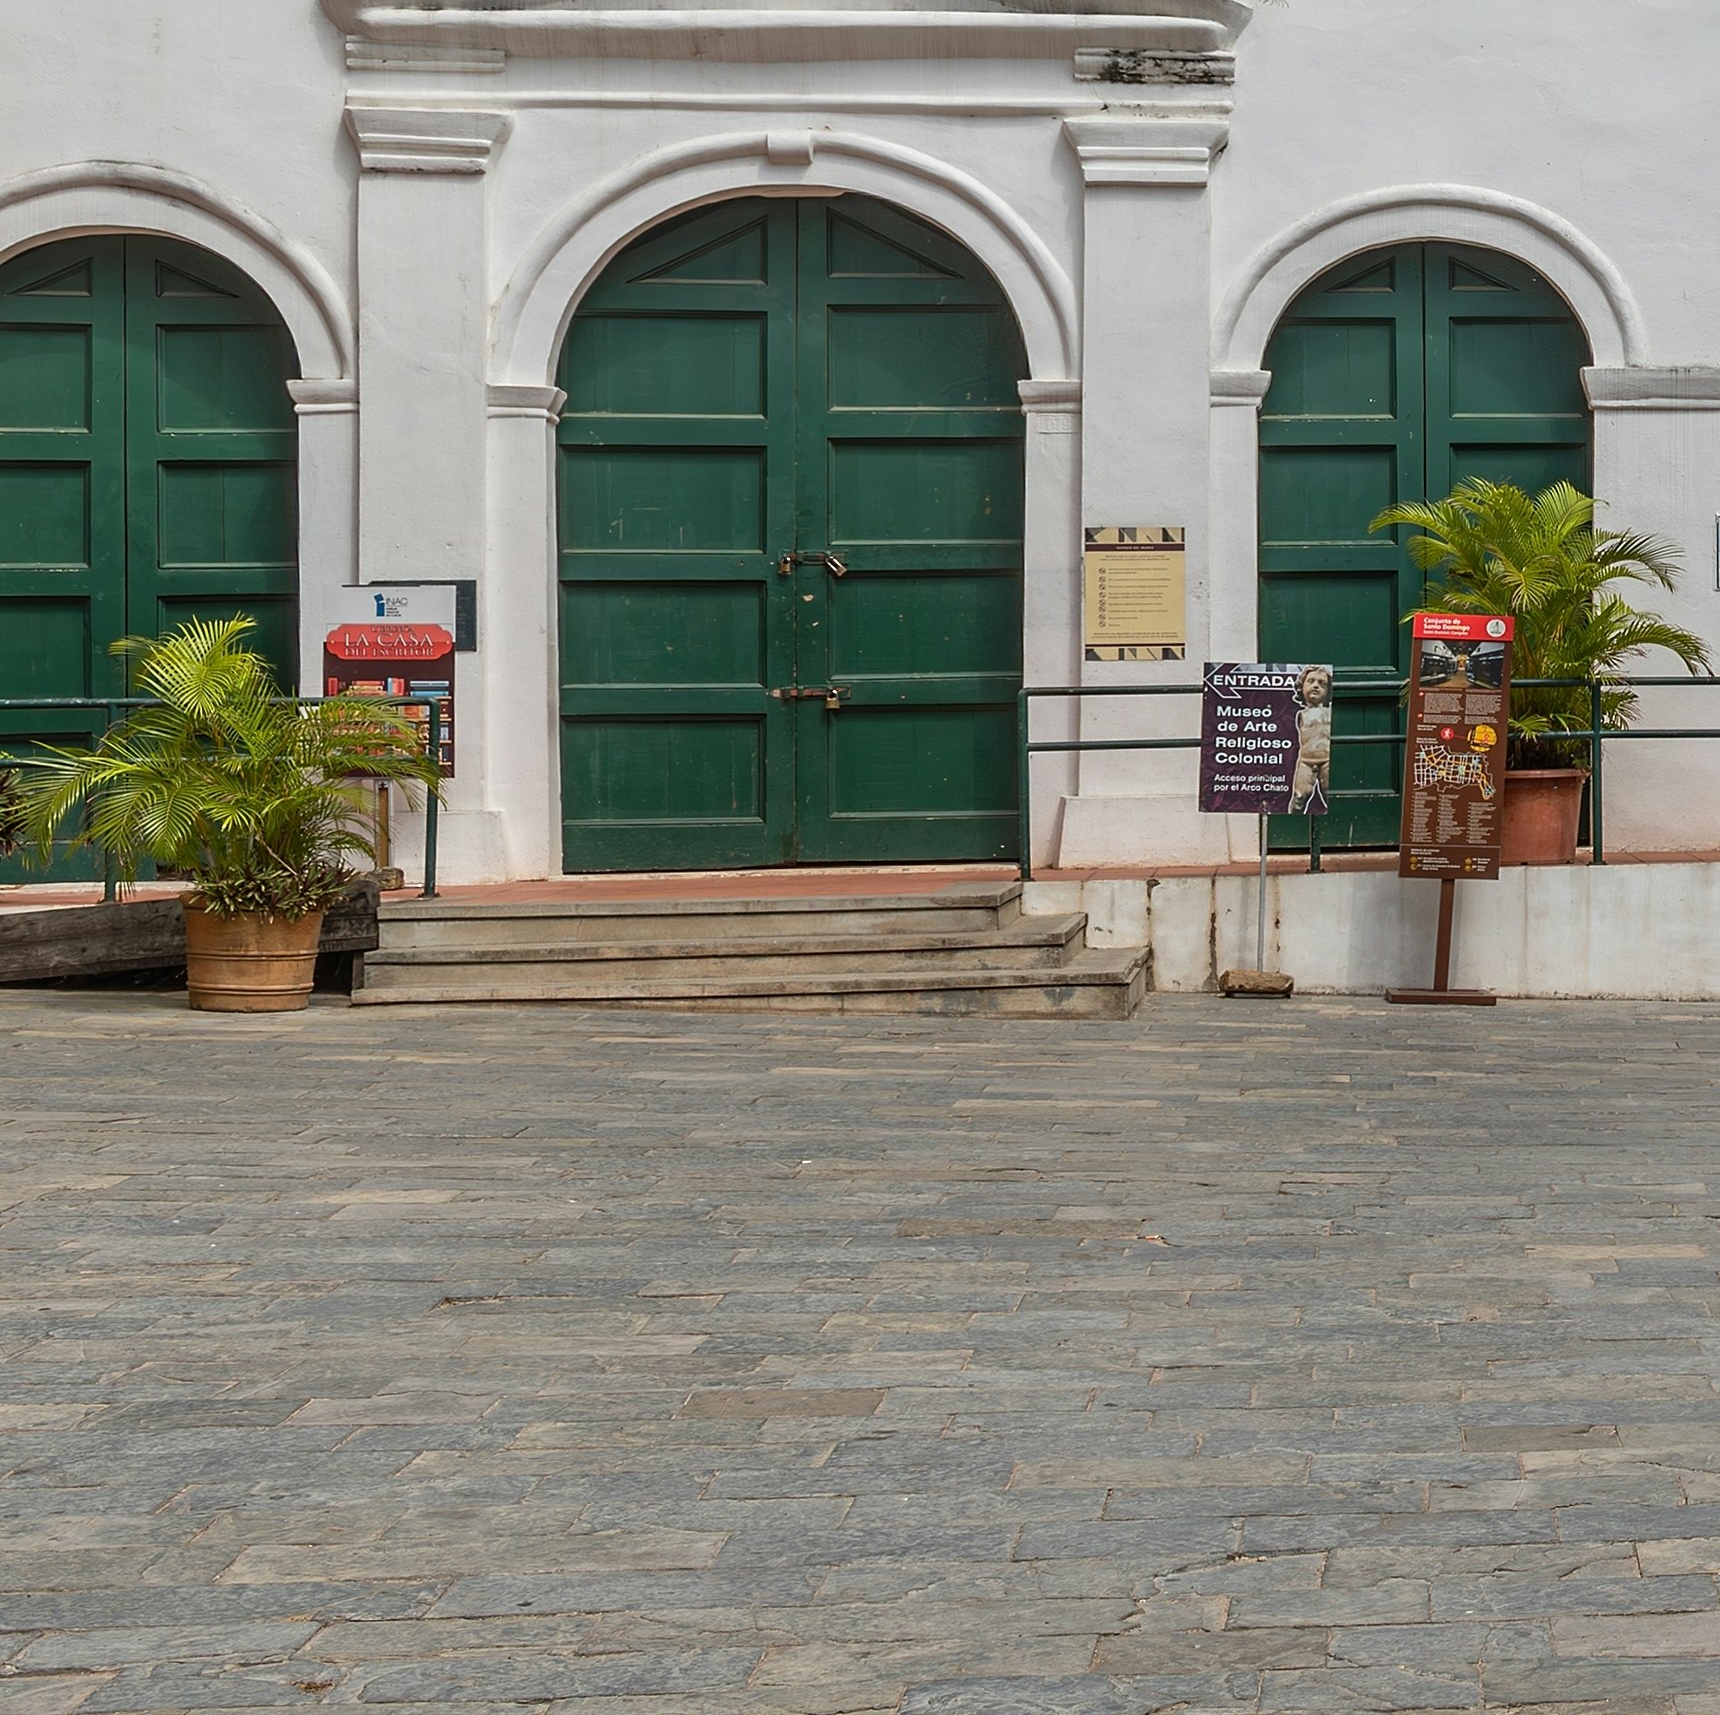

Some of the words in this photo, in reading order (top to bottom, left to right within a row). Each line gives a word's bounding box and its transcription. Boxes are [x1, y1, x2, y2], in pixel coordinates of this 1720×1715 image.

[344, 633, 369, 646] LA
[377, 633, 433, 647] CASA
[1213, 675, 1295, 687] ENTRADA
[1217, 706, 1272, 717] Museo
[1217, 721, 1238, 732] de
[1244, 721, 1277, 732] Arte
[1215, 737, 1292, 750] Religioso
[1215, 753, 1283, 764] Colonial
[1214, 774, 1246, 782] Acceso
[1241, 784, 1261, 792] Arco
[1263, 784, 1289, 792] Chato
